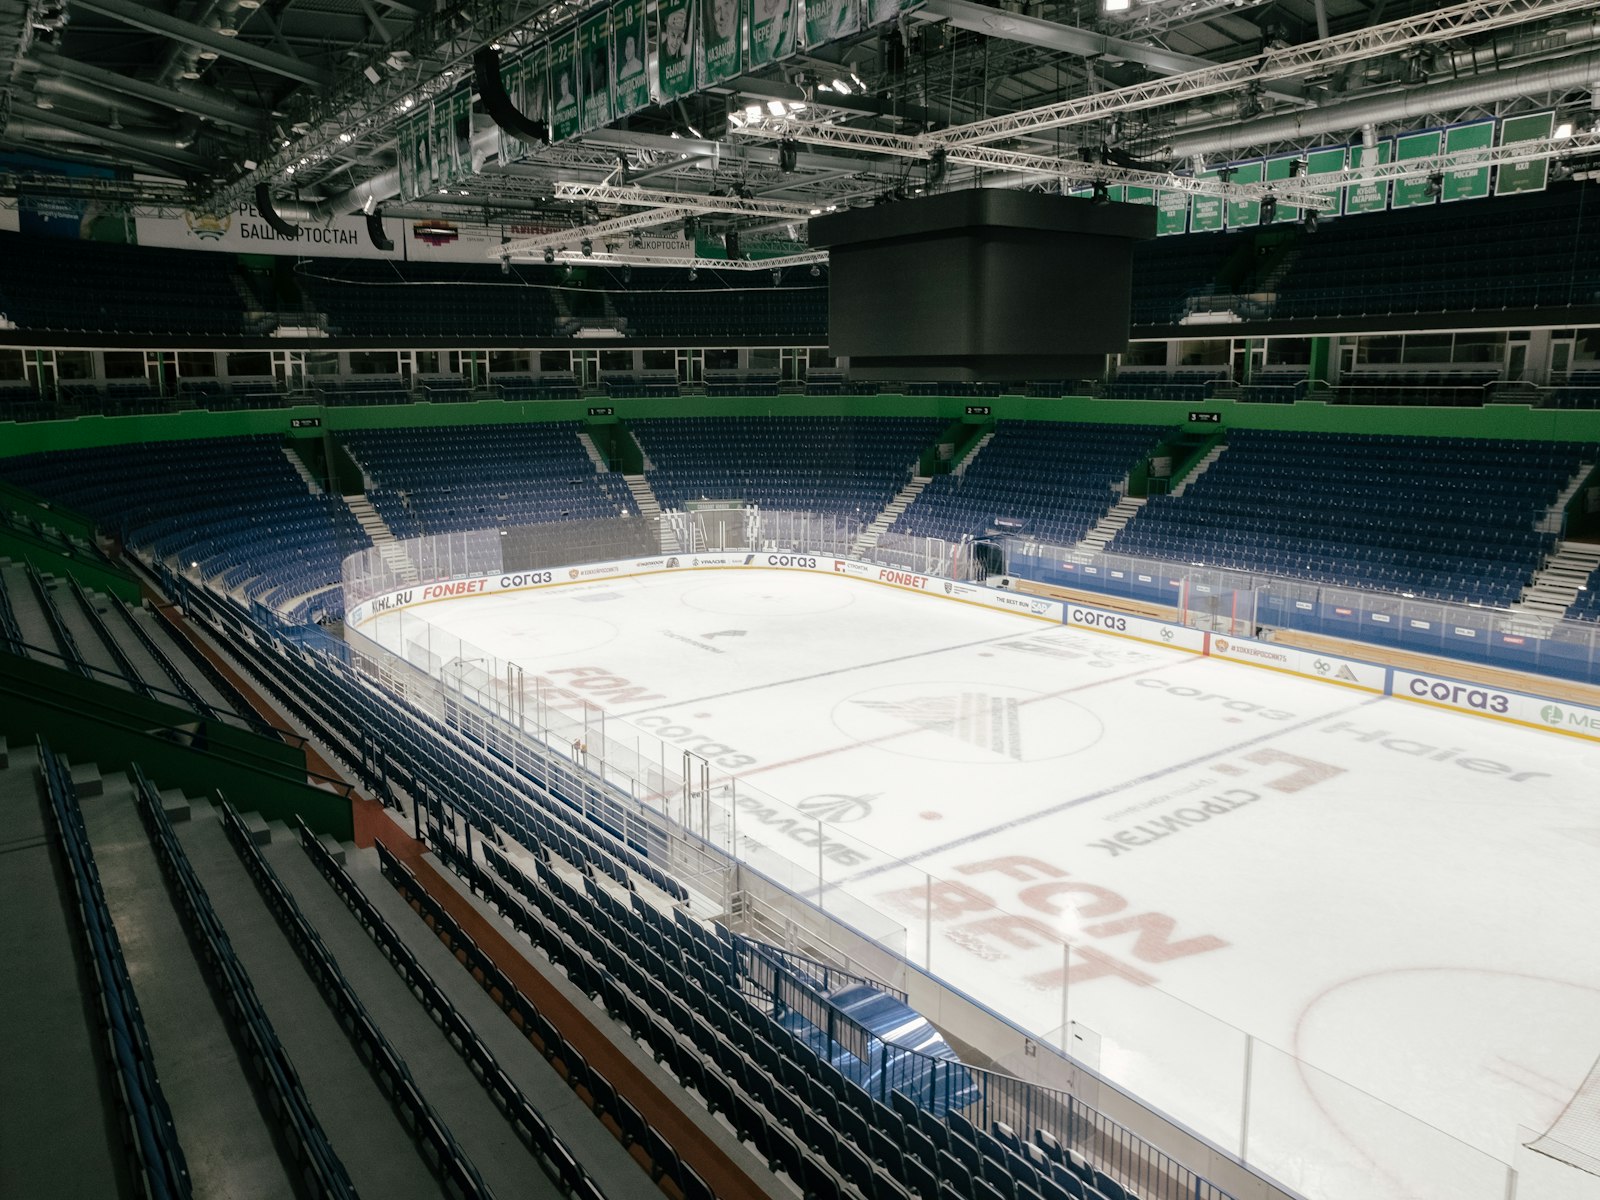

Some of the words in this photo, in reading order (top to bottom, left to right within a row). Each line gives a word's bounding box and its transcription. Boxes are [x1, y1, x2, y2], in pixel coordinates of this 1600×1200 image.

[558, 43, 567, 63] 22
[708, 40, 736, 62] КАЗАКОВ
[666, 60, 687, 79] БЫКОВ
[1191, 413, 1197, 421] 3
[1212, 414, 1218, 422] 4
[878, 569, 929, 589] FONBET
[422, 579, 488, 600] FONBET
[1320, 720, 1552, 783] Haier
[953, 855, 1233, 964] FON
